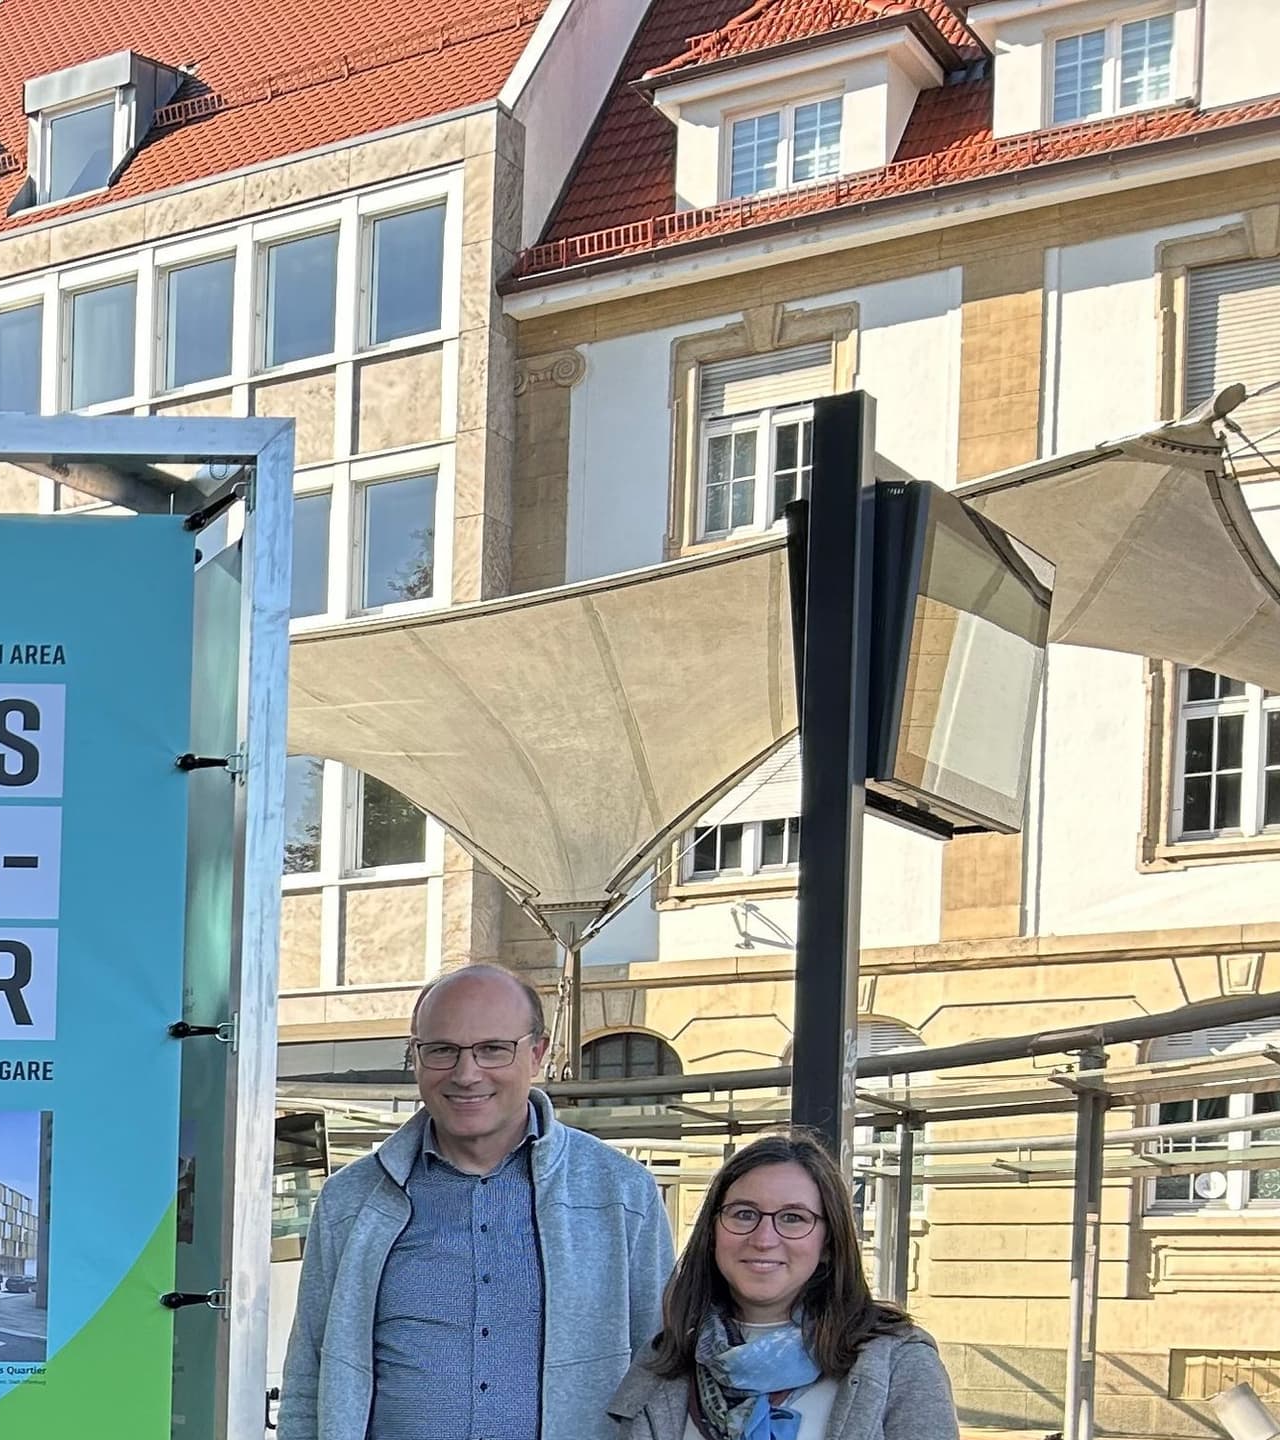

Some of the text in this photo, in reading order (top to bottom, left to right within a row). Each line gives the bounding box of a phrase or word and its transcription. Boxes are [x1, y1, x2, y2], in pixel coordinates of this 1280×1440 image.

[9, 644, 66, 665] AREA
[0, 1061, 54, 1080] GARE
[7, 1366, 46, 1374] Quartier
